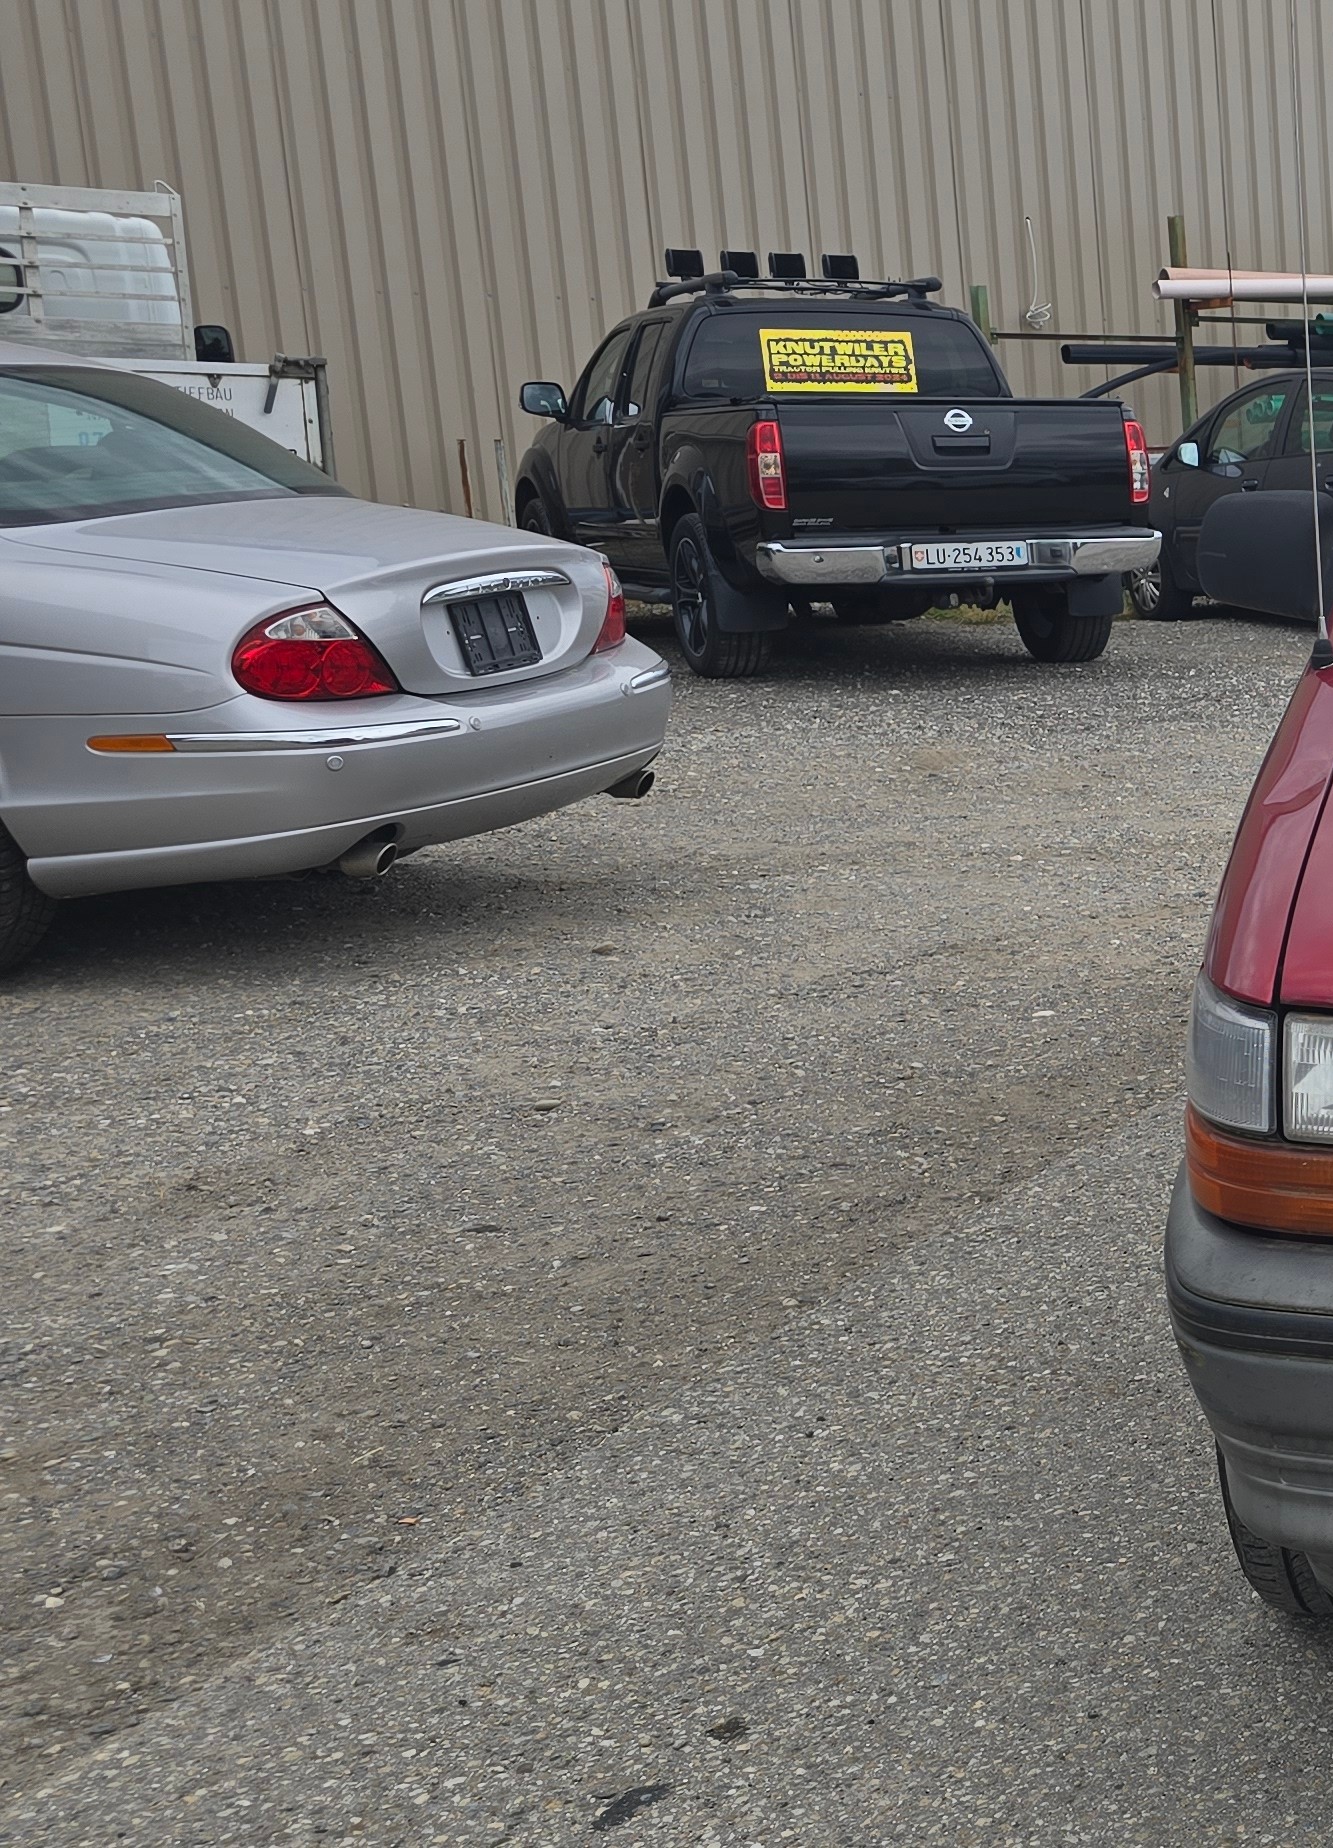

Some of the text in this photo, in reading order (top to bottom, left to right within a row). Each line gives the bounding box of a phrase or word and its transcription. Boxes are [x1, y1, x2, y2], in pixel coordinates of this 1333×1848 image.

[769, 341, 906, 356] KNUTWILER
[771, 354, 907, 367] POWERDAYS
[825, 373, 874, 381] AUGUST
